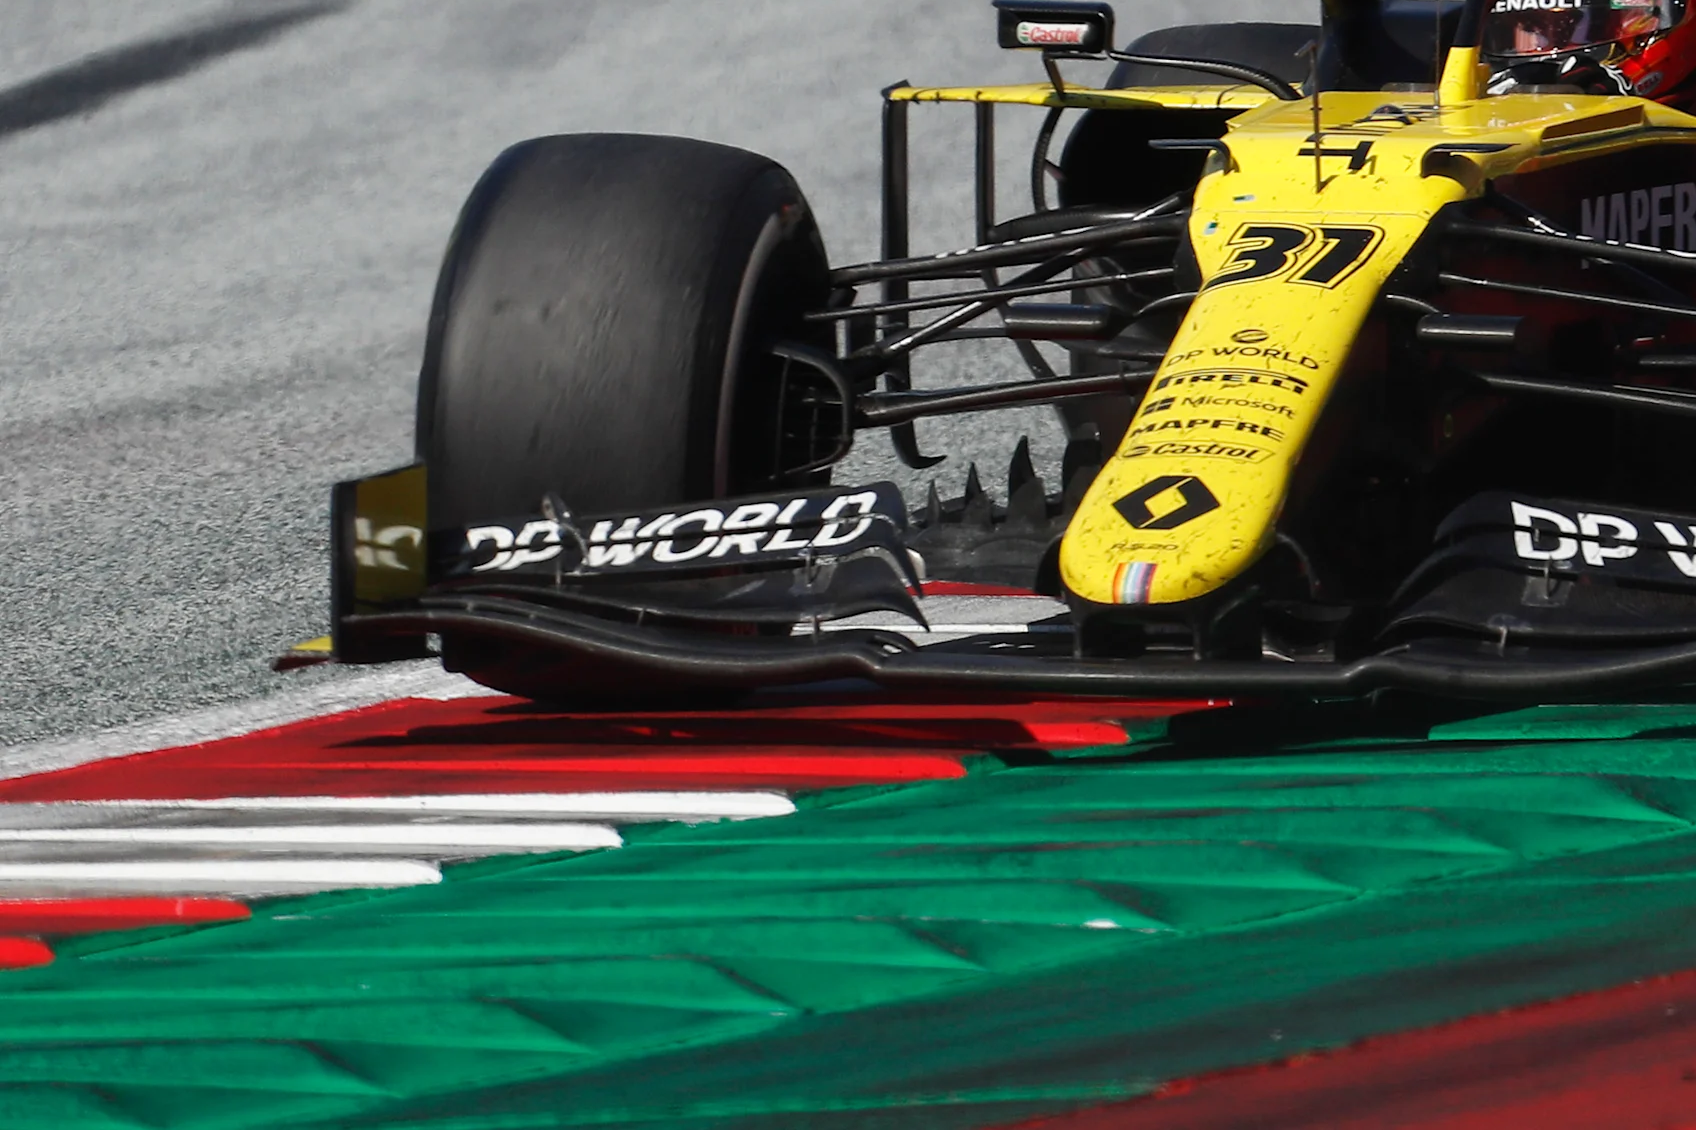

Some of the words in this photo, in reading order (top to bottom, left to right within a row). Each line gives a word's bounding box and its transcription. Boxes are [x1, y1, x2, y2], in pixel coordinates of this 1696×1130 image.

[1198, 221, 1385, 290] 31
[1166, 350, 1204, 367] DP
[1212, 347, 1319, 370] WORLD
[1153, 368, 1309, 395] PIRELLI
[1181, 395, 1296, 419] Microsoft
[1129, 419, 1286, 441] MAPFRE
[1153, 442, 1259, 458] Castrol
[467, 519, 563, 572] DP
[585, 491, 877, 568] WORLD
[1511, 501, 1638, 567] DP
